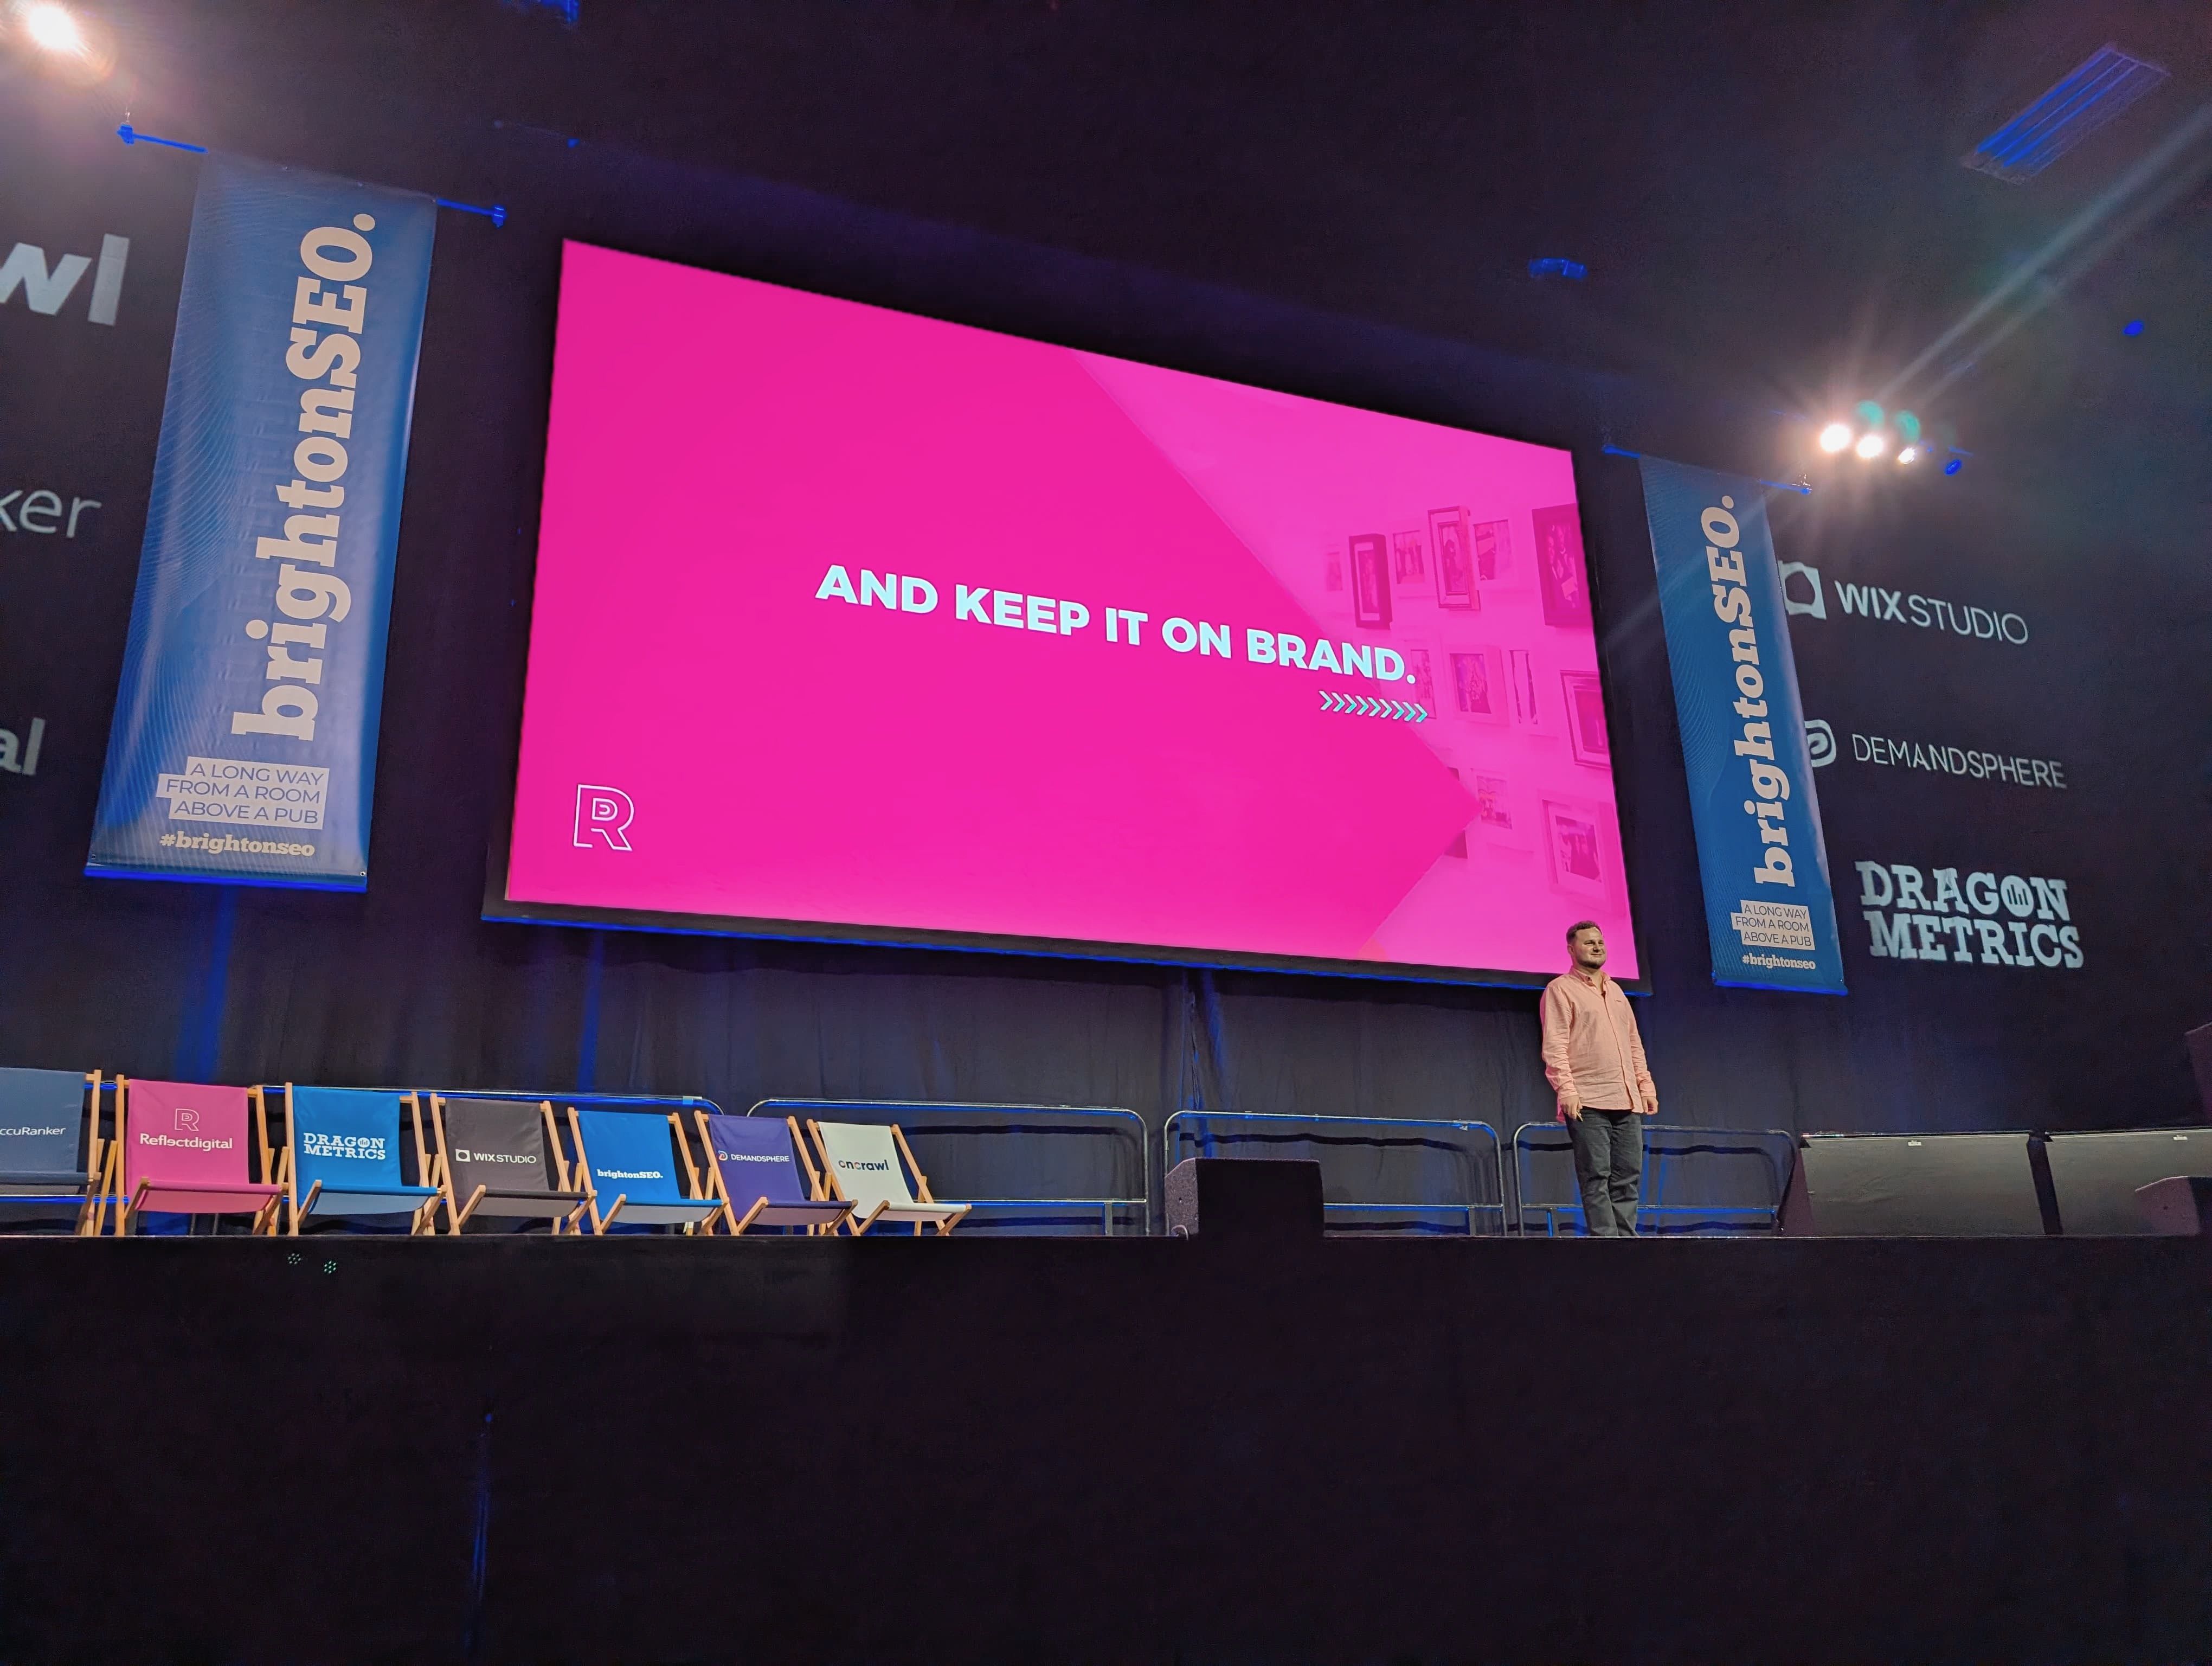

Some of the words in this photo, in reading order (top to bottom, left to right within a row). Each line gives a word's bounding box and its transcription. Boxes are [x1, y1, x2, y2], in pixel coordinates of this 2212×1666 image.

[232, 213, 375, 741] brightonSEO.
[814, 564, 938, 614] AND
[954, 585, 1090, 636] KEEP
[1105, 607, 1148, 646] IT
[1162, 617, 1231, 659] ON
[1246, 628, 1416, 684] BRAND.
[1701, 495, 1795, 887] brightonSEO.
[1852, 734, 2067, 789] DEMANDSPHERE
[190, 763, 205, 777] A
[211, 764, 271, 781] LONG
[276, 770, 324, 786] WAY
[166, 779, 230, 797] FROM
[234, 785, 249, 798] A
[254, 786, 320, 804] ROOM
[174, 800, 250, 819] ABOVE
[254, 806, 269, 821] A
[274, 808, 318, 824] PUB
[160, 831, 316, 856] #brightonseo
[1855, 861, 2071, 922] DRAGON
[1744, 904, 1752, 914] A
[1754, 905, 1782, 917] LONG
[1784, 908, 1806, 919] WAY
[1735, 916, 1766, 928] FROM
[1768, 919, 1776, 929] A
[1778, 920, 1809, 932] ROOM
[1744, 932, 1779, 944] ABOVE
[1781, 934, 1789, 944] A
[1791, 935, 1812, 946] PUB
[1863, 910, 2084, 969] METRICS
[1742, 952, 1816, 970] #brightonseo
[303, 1132, 385, 1149] DRAGON
[304, 1143, 386, 1160] METRICS
[730, 1154, 790, 1162] DEMANDSPHERE
[838, 1159, 889, 1170] oncrawl
[597, 1168, 664, 1179] brightonSEO.
